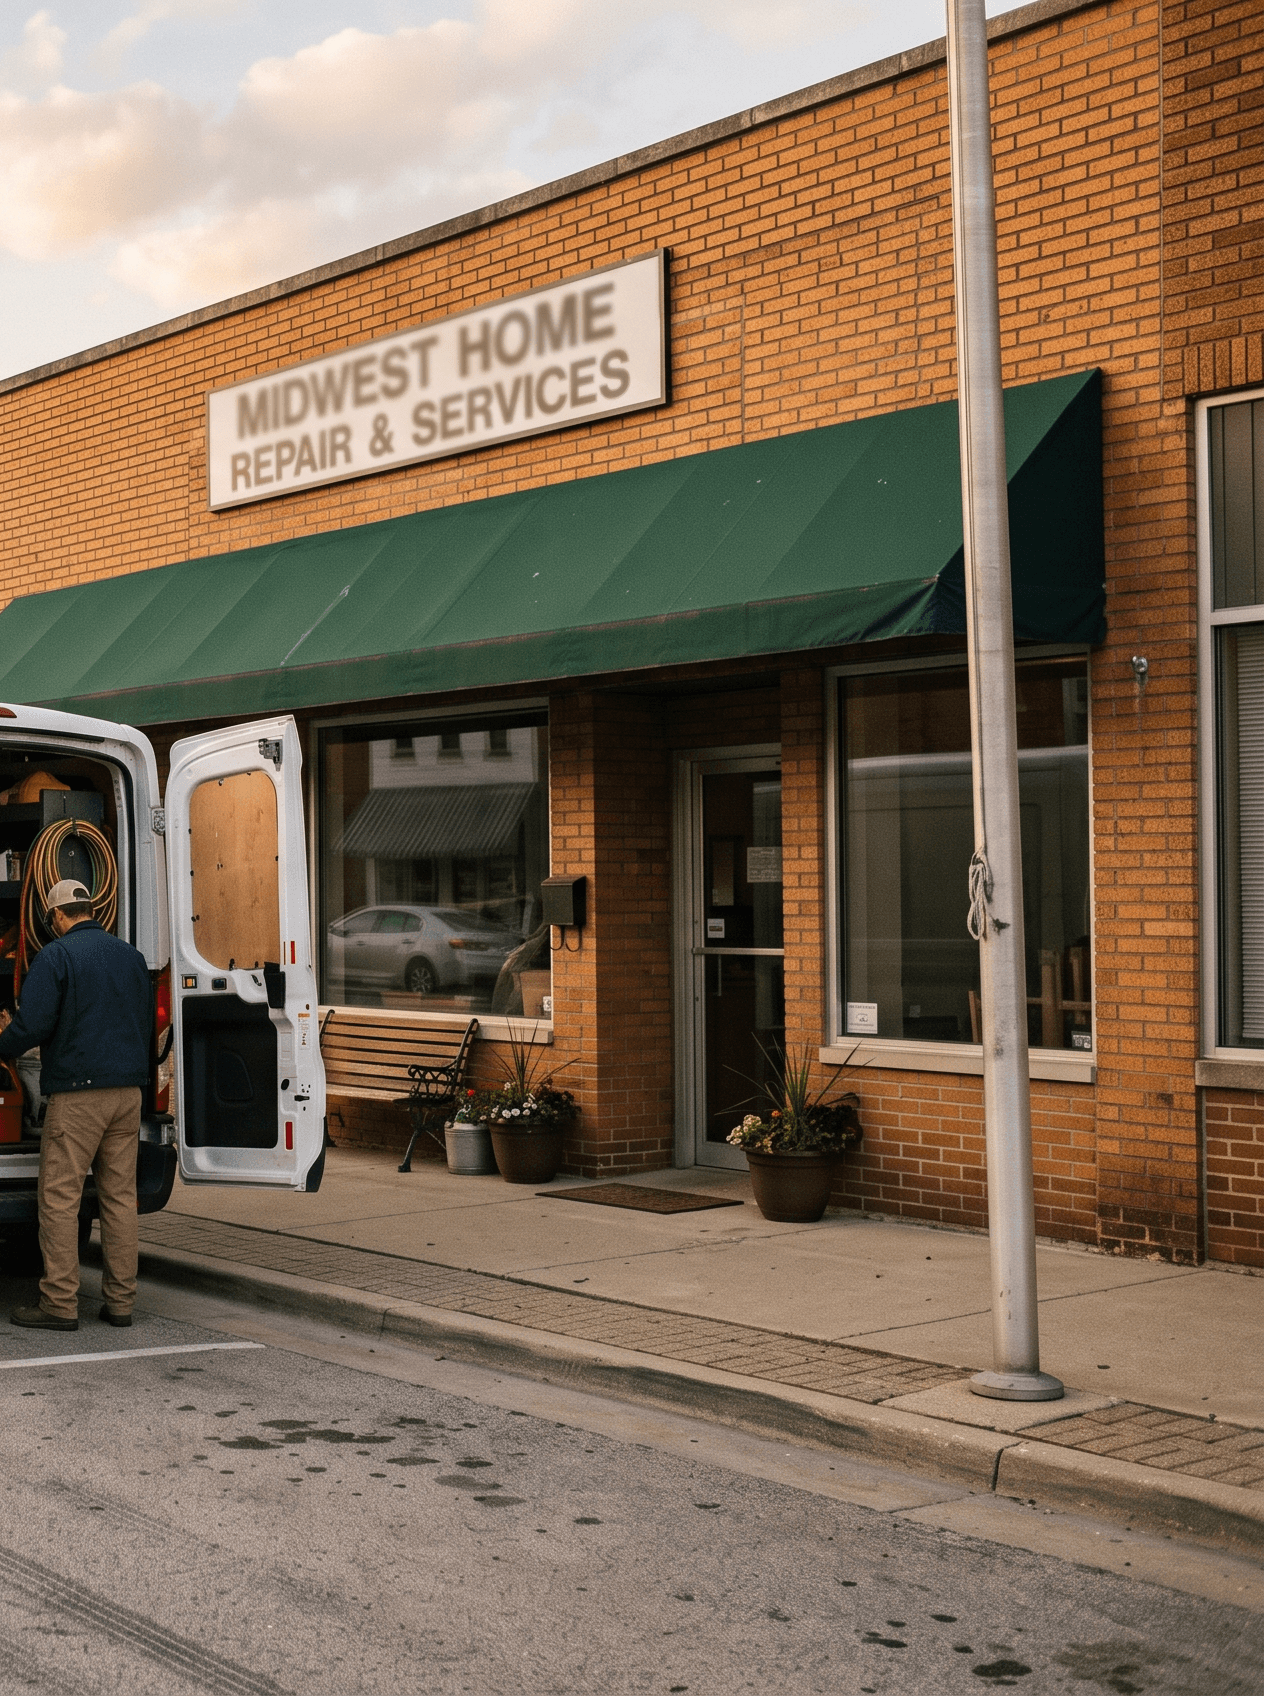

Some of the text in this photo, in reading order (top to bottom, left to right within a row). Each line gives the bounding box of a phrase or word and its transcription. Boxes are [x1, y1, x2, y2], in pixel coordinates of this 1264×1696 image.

[230, 348, 630, 493] REPAIR & SERVICES
[235, 281, 616, 441] MIDWEST HOME
